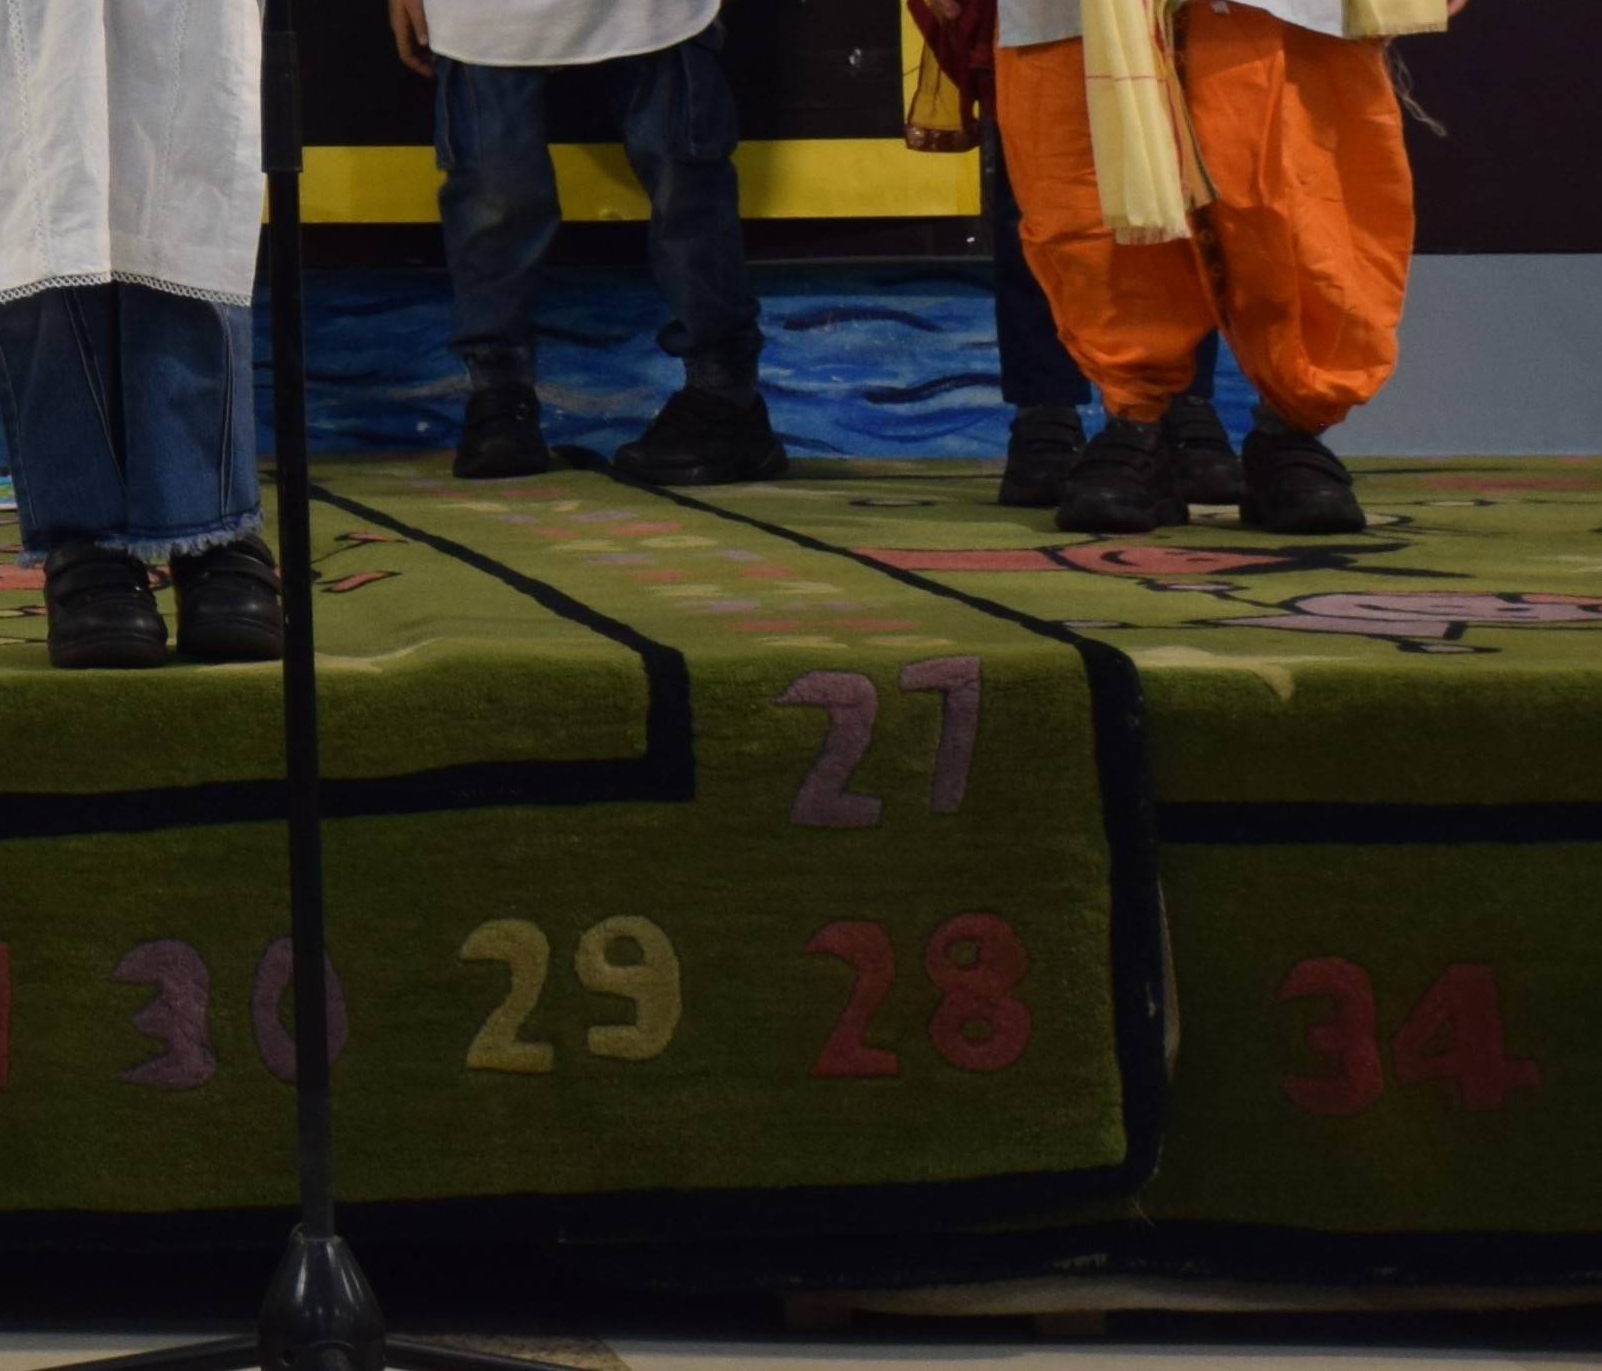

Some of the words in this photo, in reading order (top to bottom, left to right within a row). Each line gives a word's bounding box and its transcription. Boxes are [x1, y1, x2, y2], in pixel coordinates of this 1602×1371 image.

[774, 655, 981, 829] 27
[112, 934, 348, 1091] 30
[459, 915, 682, 1074] 29
[804, 913, 1031, 1078] 28
[1278, 955, 1540, 1117] 34
